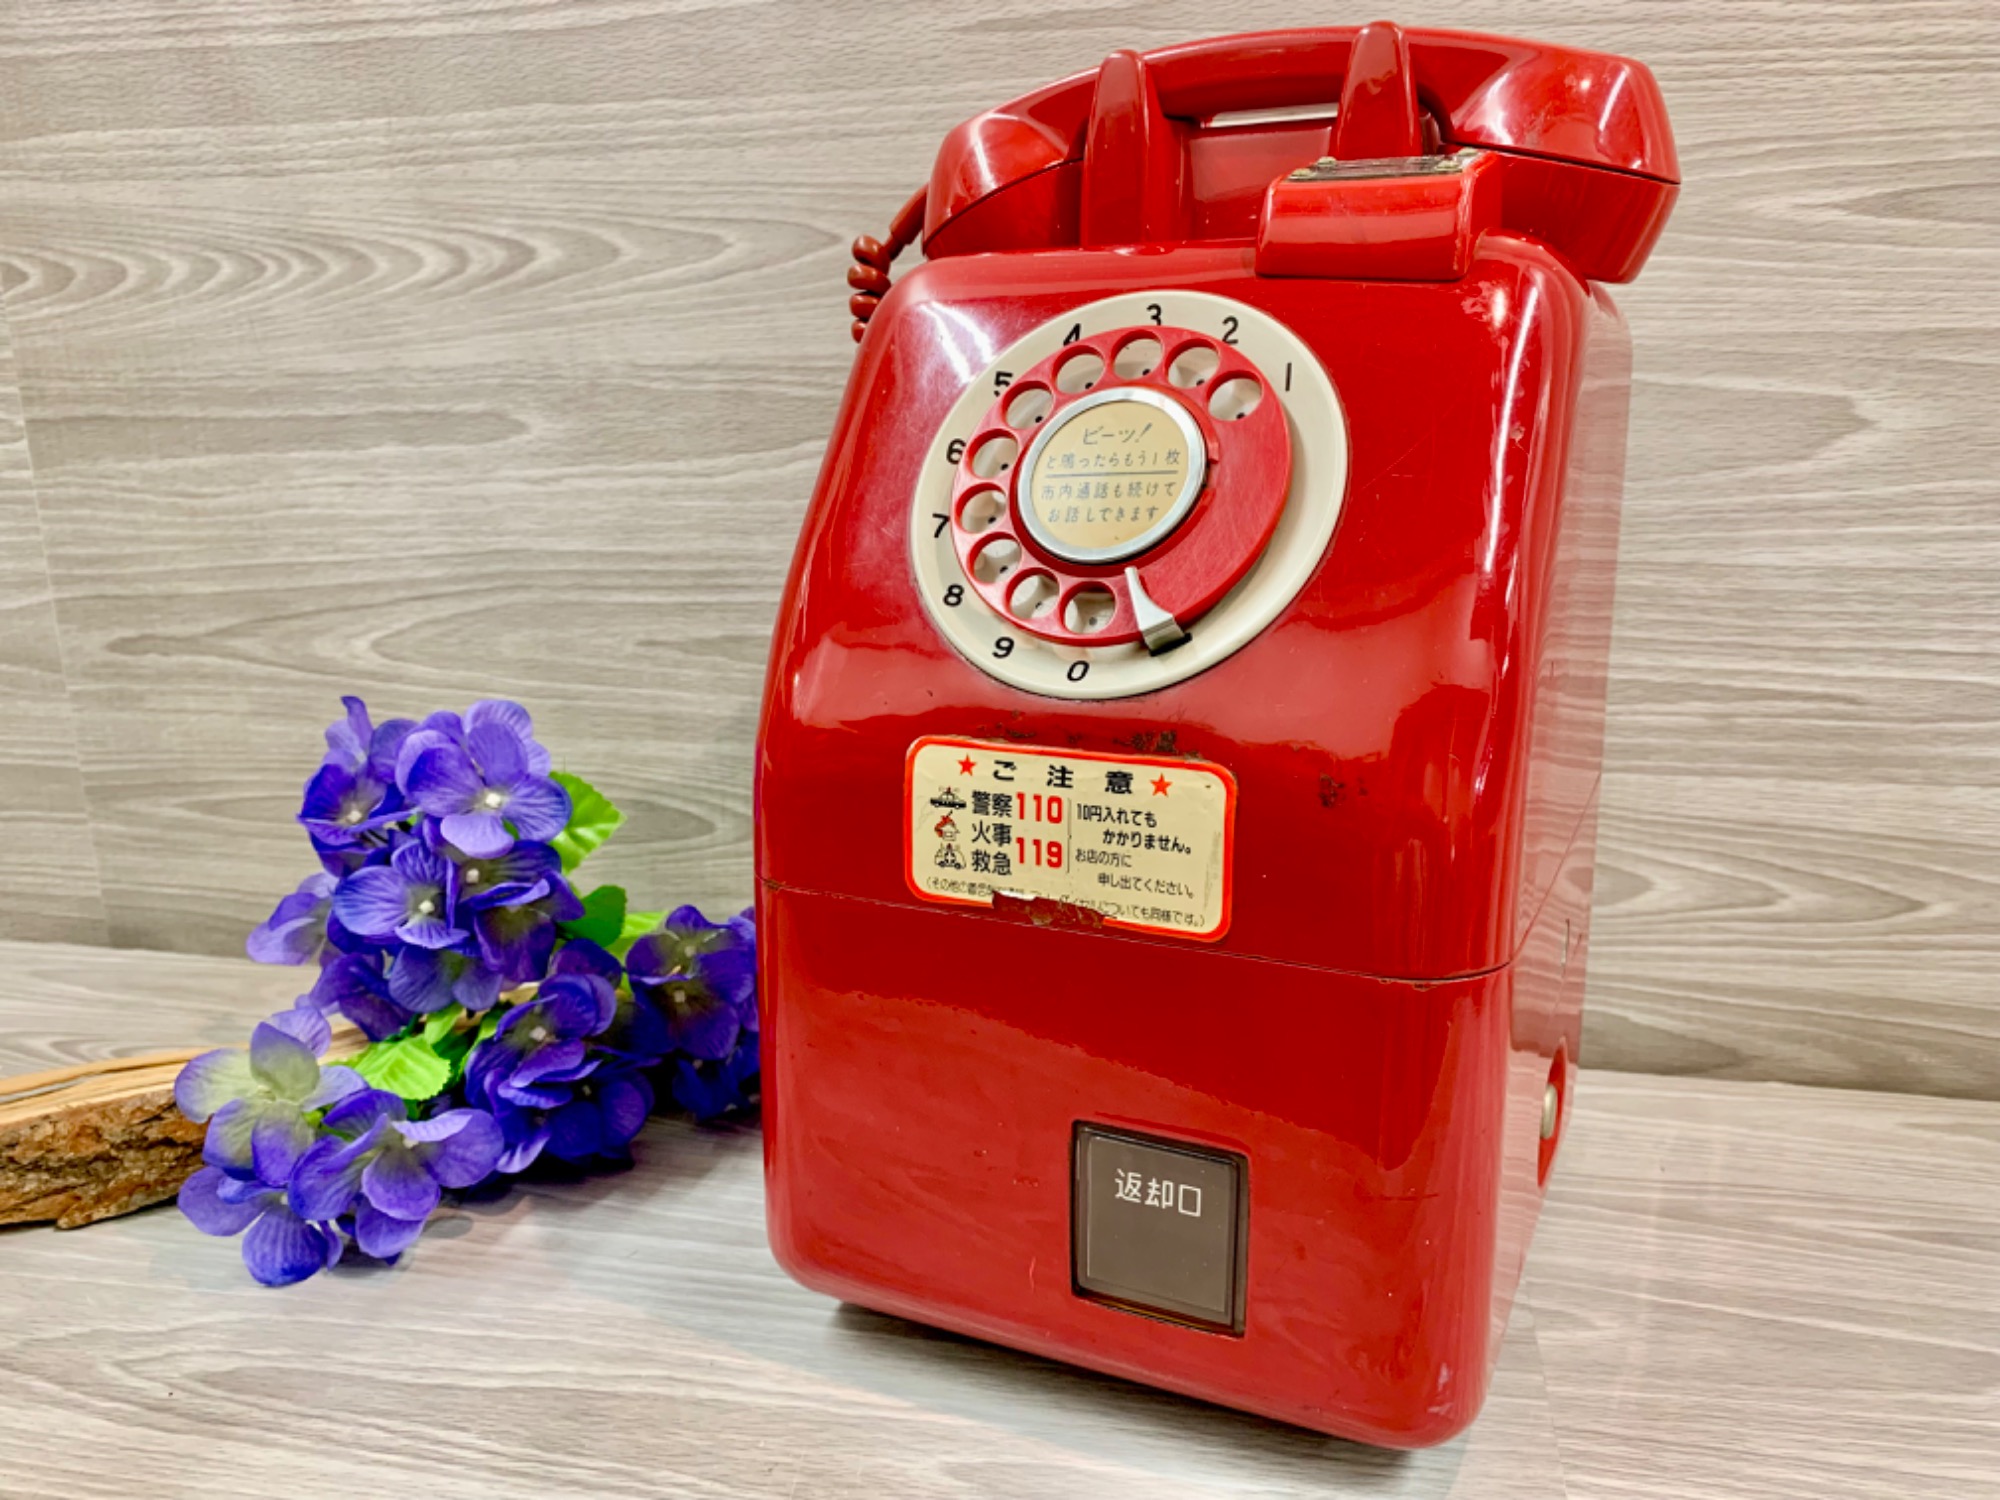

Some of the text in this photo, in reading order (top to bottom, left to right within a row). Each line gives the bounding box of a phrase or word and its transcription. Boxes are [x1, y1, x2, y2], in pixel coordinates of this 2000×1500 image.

[1146, 304, 1162, 325] 3
[1062, 323, 1082, 345] 4
[1222, 316, 1239, 344] 2
[994, 371, 1013, 397] 5
[1284, 362, 1292, 392] 1
[946, 439, 967, 464] 6
[932, 513, 950, 538] 7
[1047, 505, 1160, 524] お話しできます
[943, 584, 965, 607] 8
[992, 636, 1014, 658] 9
[1066, 660, 1090, 682] 0
[1015, 791, 1063, 824] 110
[970, 821, 1013, 848] 火事
[1102, 828, 1192, 855] かかりません。
[970, 850, 1013, 877] 救急
[1015, 837, 1063, 869] 119
[1075, 848, 1133, 868] お店の方に
[1097, 874, 1195, 900] 申し出てください。
[1114, 1167, 1202, 1218] 返却口
